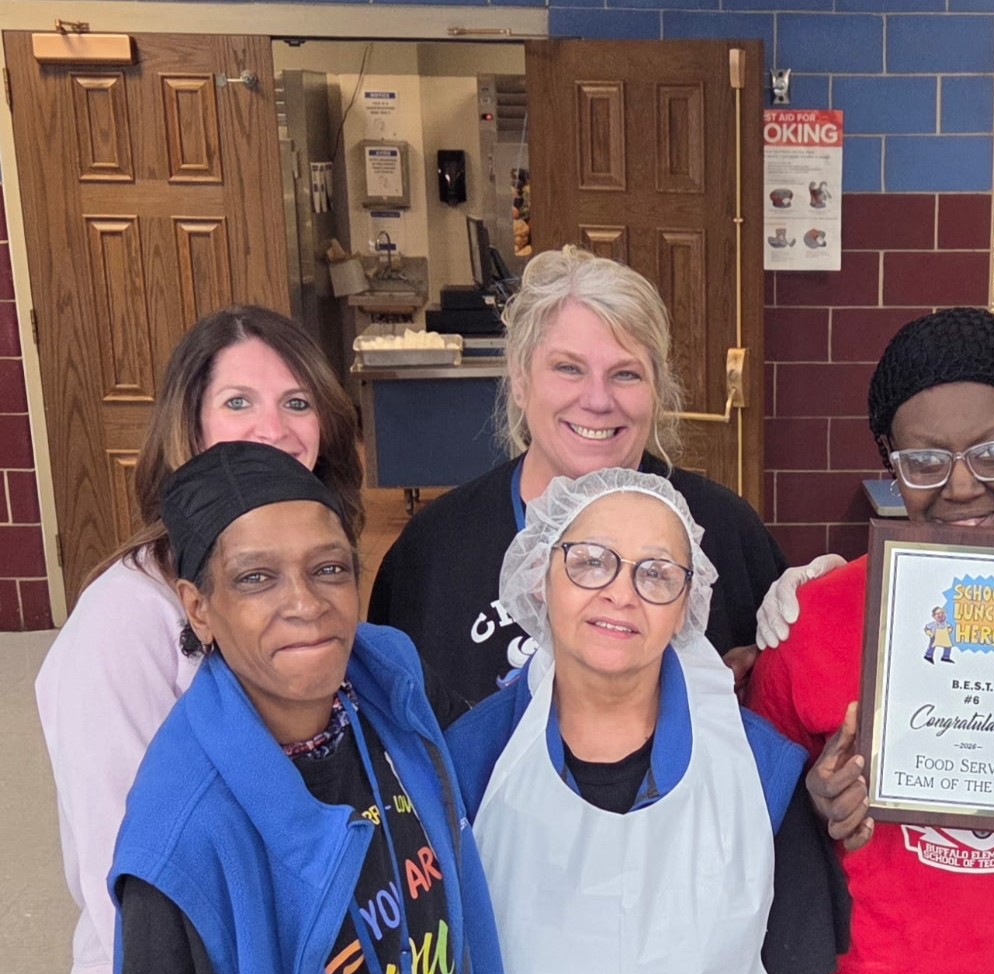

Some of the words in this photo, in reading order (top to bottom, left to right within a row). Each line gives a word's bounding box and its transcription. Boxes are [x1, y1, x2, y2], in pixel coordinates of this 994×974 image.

[779, 113, 795, 121] AID
[797, 113, 816, 122] FOR
[764, 123, 838, 143] OKING
[952, 680, 993, 692] B.E.S.T.
[964, 696, 980, 705] #6
[923, 851, 960, 867] SCHOOL
[963, 859, 975, 867] OF
[925, 843, 969, 859] BUFFALO
[405, 846, 443, 899] AR
